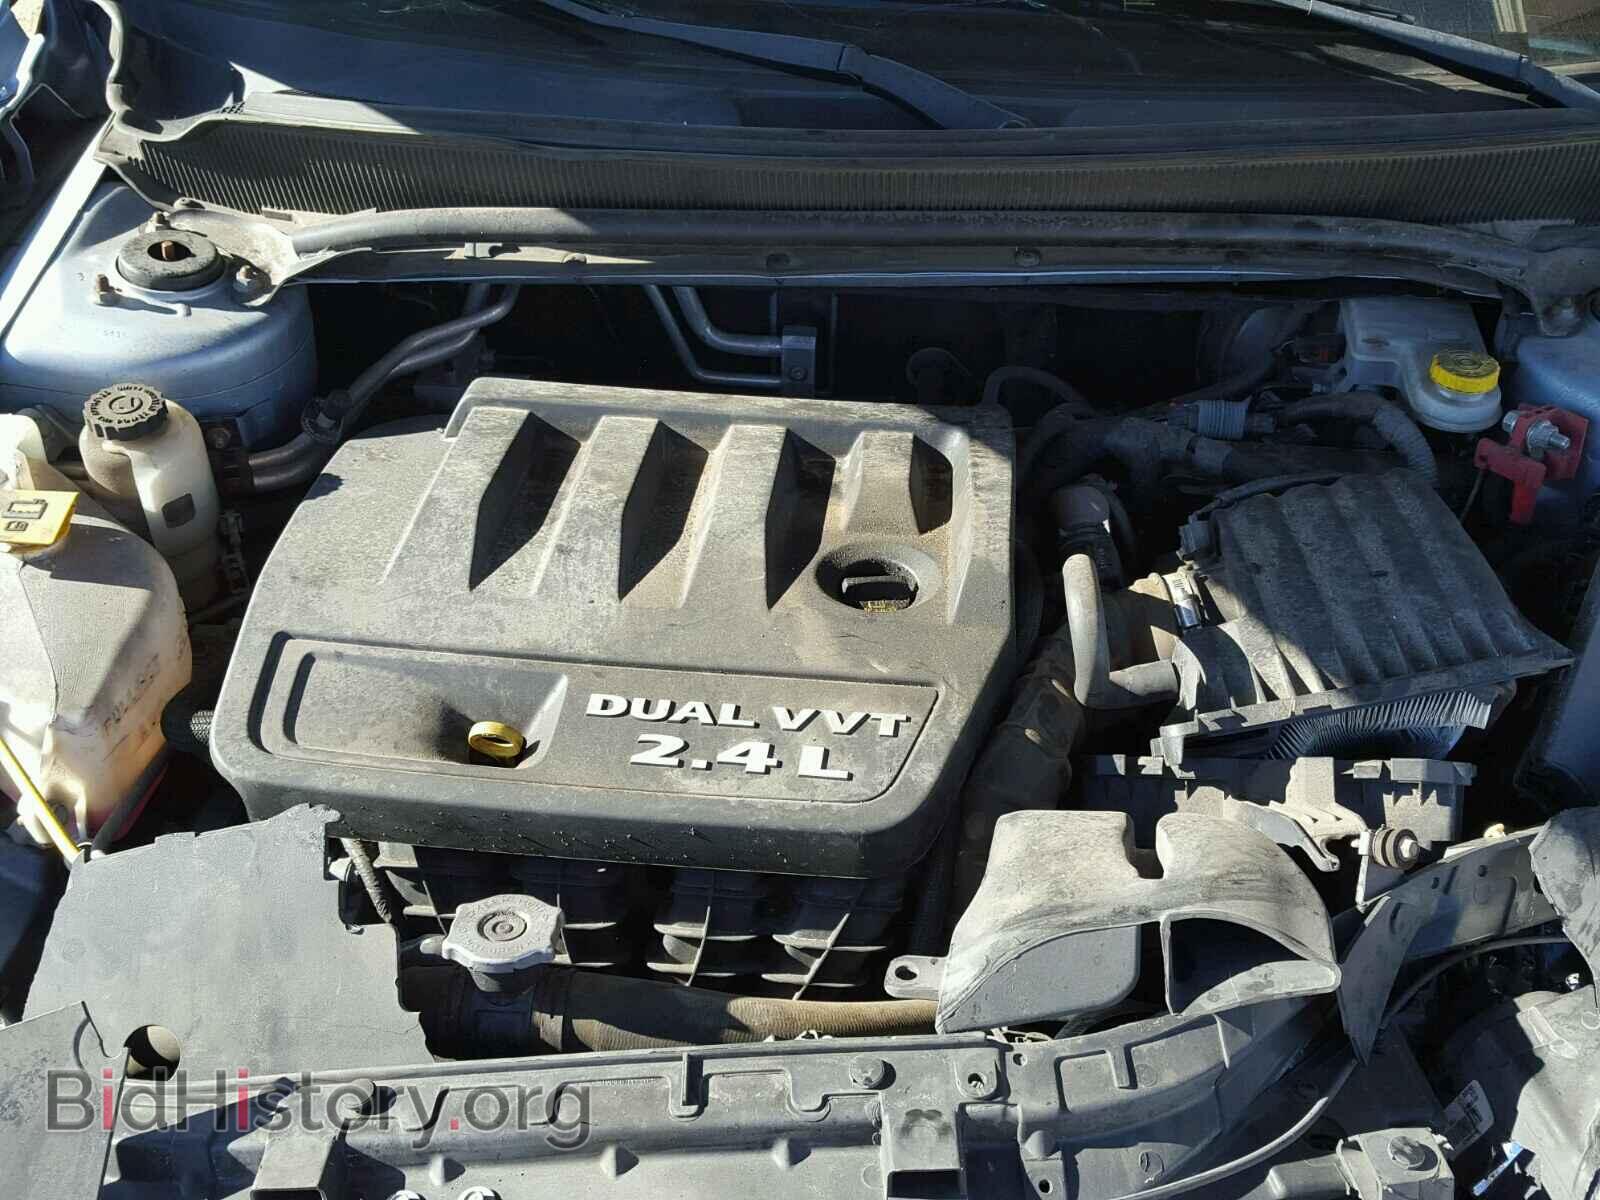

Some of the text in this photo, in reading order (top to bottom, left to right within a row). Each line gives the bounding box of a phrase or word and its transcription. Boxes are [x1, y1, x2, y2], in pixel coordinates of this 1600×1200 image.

[586, 693, 911, 737] DUAL VVT
[630, 734, 853, 781] 2.4 L
